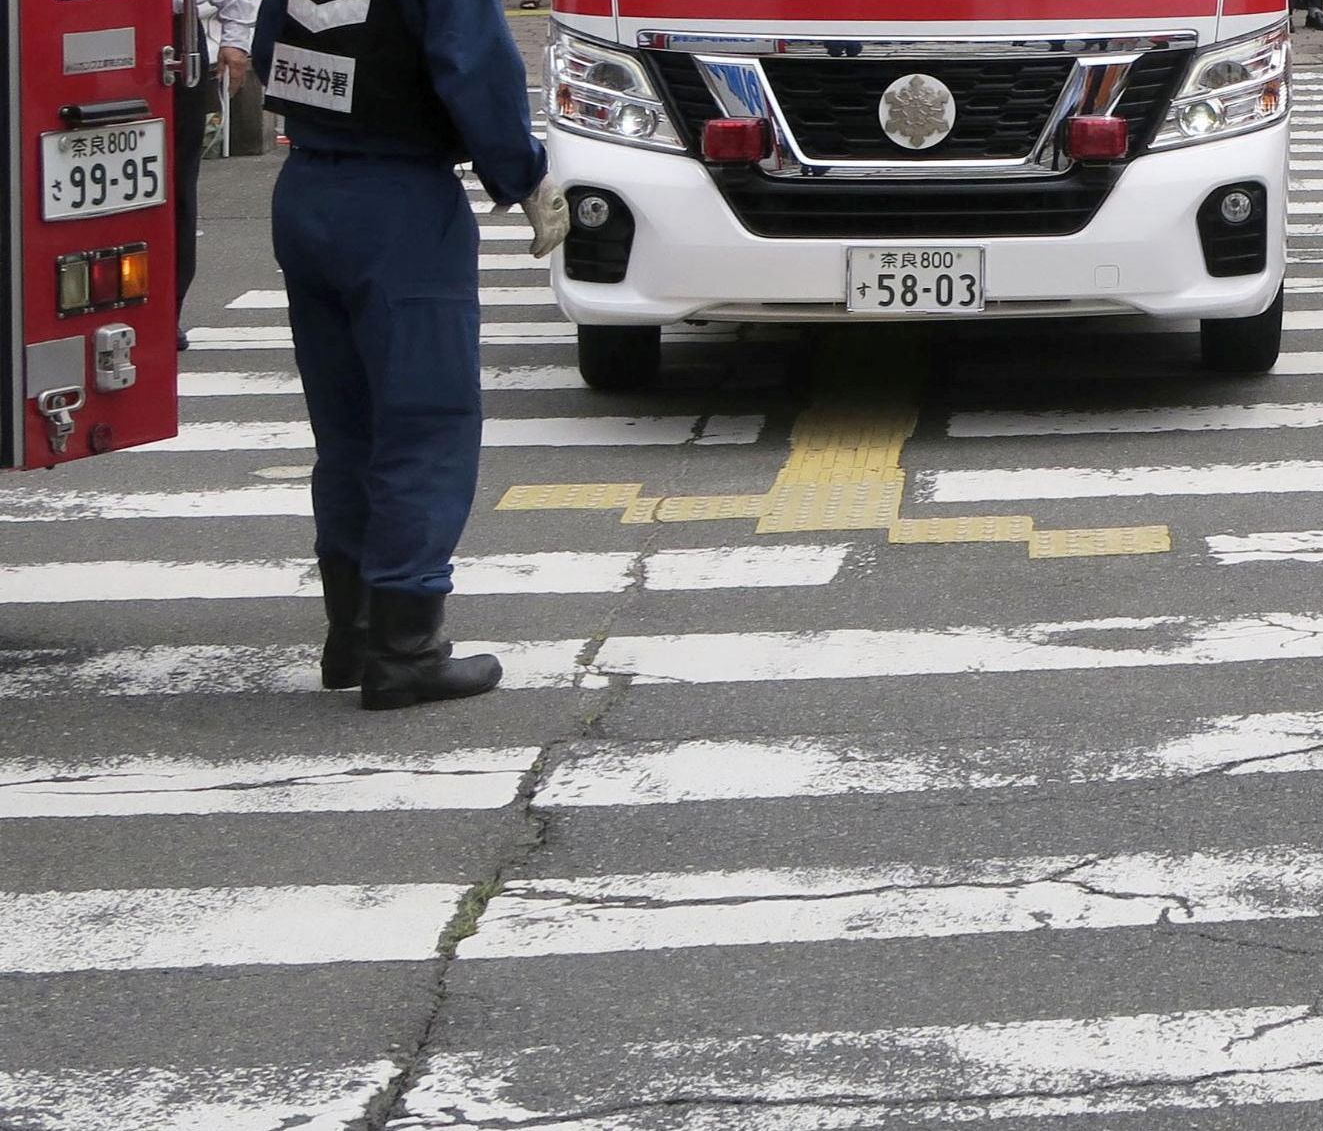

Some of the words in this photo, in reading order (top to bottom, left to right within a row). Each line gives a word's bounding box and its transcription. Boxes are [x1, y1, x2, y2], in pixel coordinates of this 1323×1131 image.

[273, 58, 349, 97] 西大寺分署
[51, 180, 62, 201] さ
[70, 155, 158, 209] 99-95
[856, 281, 871, 300] す
[877, 273, 977, 306] 58-03
